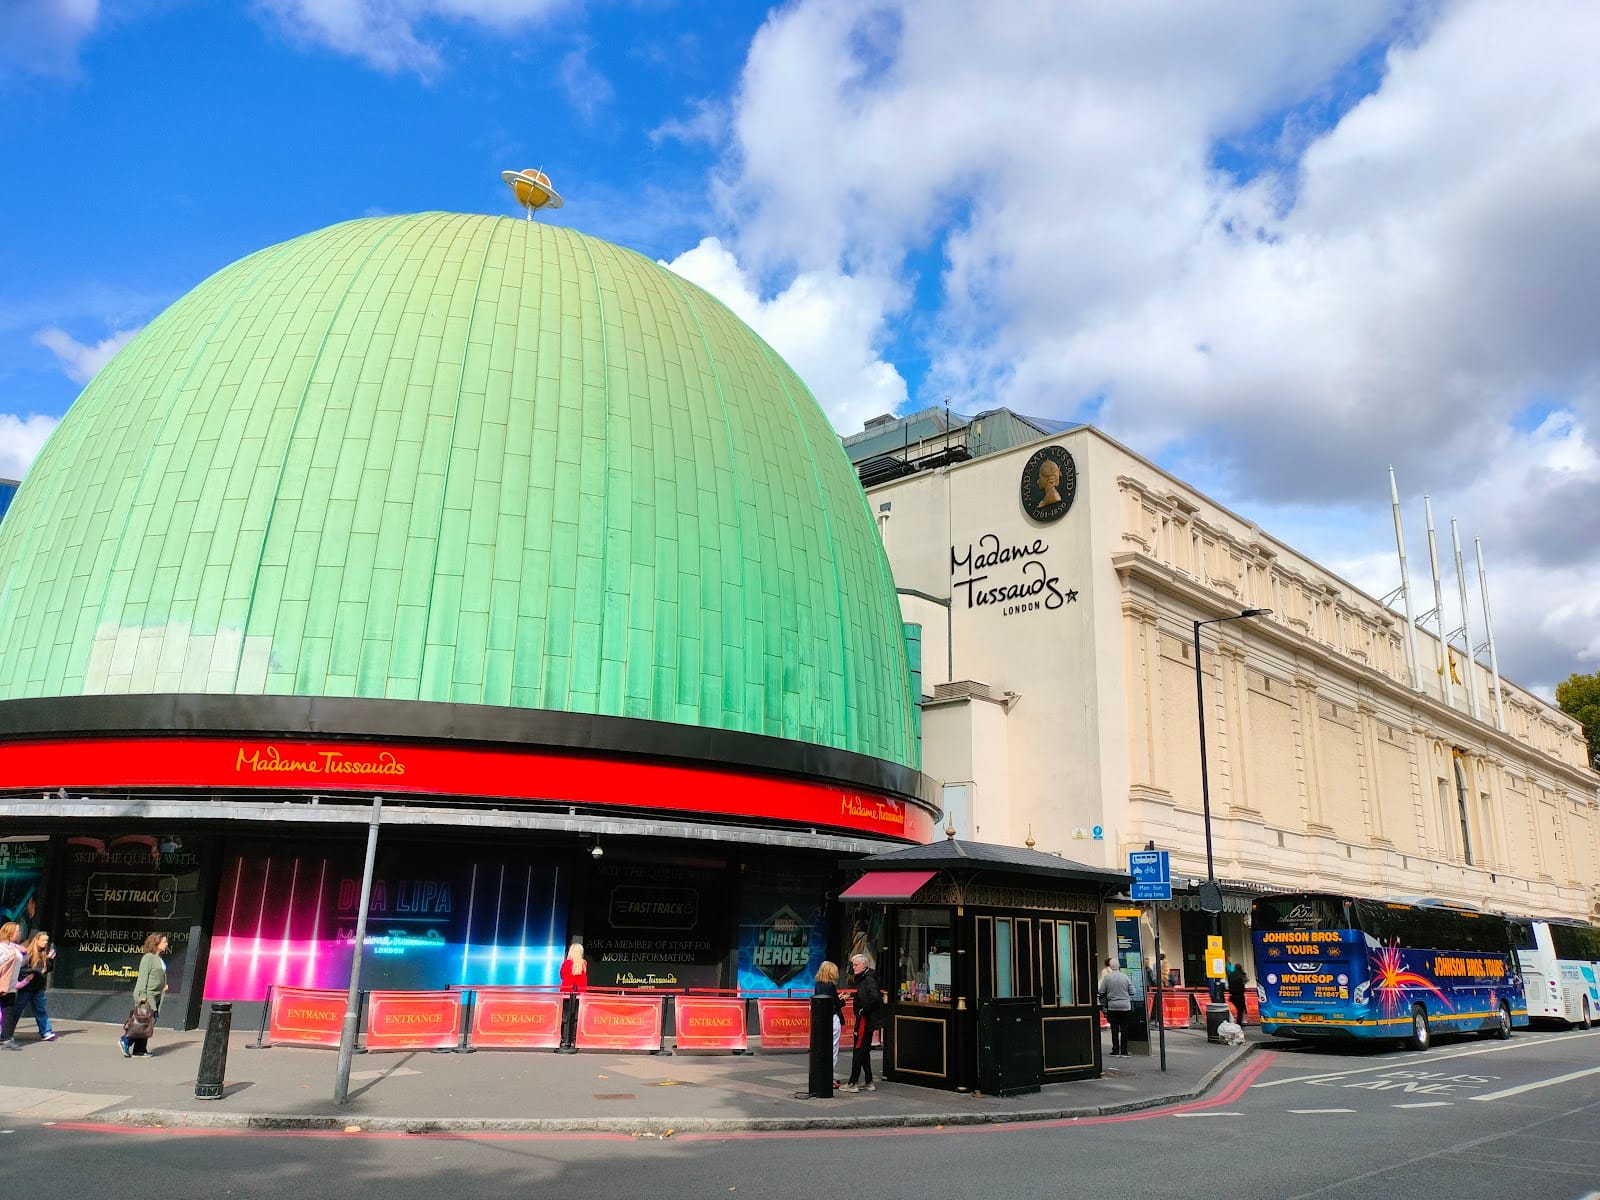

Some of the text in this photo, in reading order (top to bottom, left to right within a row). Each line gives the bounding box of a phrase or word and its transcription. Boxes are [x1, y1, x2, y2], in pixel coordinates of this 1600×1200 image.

[1023, 447, 1074, 501] MADAME TUSSAUD
[950, 533, 1049, 576] Madame
[953, 560, 1064, 610] Tussauds
[1003, 601, 1040, 617] LONDON
[235, 745, 406, 775] Madame Tussauds
[841, 794, 905, 825] Madame Tussauds
[100, 852, 122, 864] THE
[396, 879, 451, 912] LIPA
[64, 929, 82, 939] ASK
[82, 930, 90, 939] A
[91, 930, 130, 940] MEMBER
[131, 931, 144, 940] OF
[770, 933, 794, 945] HALL
[1263, 931, 1342, 943] JOHNSON BROS.
[79, 943, 106, 952] MORE
[587, 940, 604, 949] ASK
[605, 940, 612, 949] A
[615, 940, 652, 950] MEMBER
[655, 940, 667, 950] OF
[1286, 945, 1319, 955] TOURS
[602, 952, 695, 962] MORE INFORMATION
[753, 946, 809, 966] HEROES
[92, 963, 124, 977] Madame
[1434, 956, 1505, 977] JOHNSON BROS. TOURS
[615, 972, 679, 985] Madame Tussauds
[1281, 974, 1334, 984] WORKSOP
[287, 1008, 337, 1021] ENTRANCE
[385, 1014, 443, 1024] ENTRANCE
[490, 1013, 544, 1024] ENTRANCE
[593, 1015, 644, 1025] ENTRANCE
[689, 1018, 733, 1027] ENTRANCE
[1376, 1070, 1501, 1083] BUS
[1304, 1076, 1481, 1096] LANE
